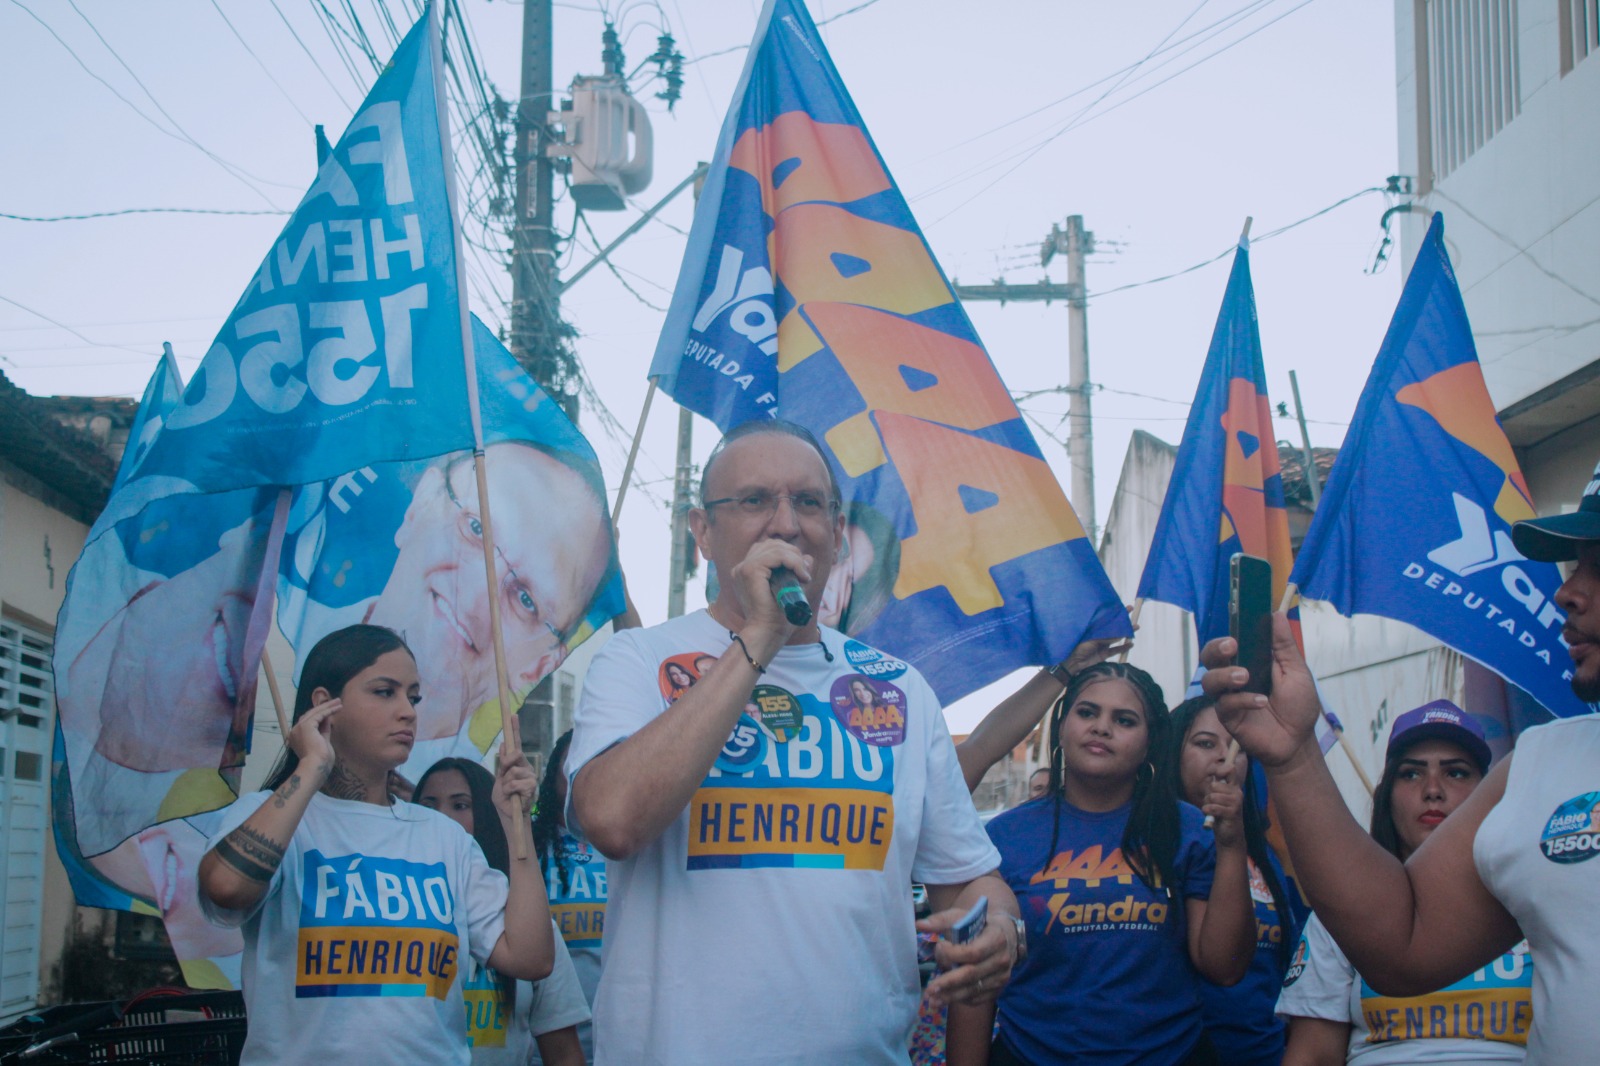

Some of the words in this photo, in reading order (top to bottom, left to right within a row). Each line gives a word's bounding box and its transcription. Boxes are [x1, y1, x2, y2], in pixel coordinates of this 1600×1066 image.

[684, 338, 756, 391] EPUTADA
[1402, 562, 1551, 666] DEPUTADA
[858, 661, 906, 675] 15500
[757, 695, 791, 713] 155
[699, 802, 888, 847] HENRIQUE
[315, 858, 452, 925] FÁBIO
[1029, 892, 1168, 935] Yandra
[1064, 922, 1116, 934] DEPUTADA
[1119, 922, 1159, 932] FEDERAL
[305, 940, 456, 979] HENRIQUE
[1368, 1001, 1529, 1040] HENRIQUE
